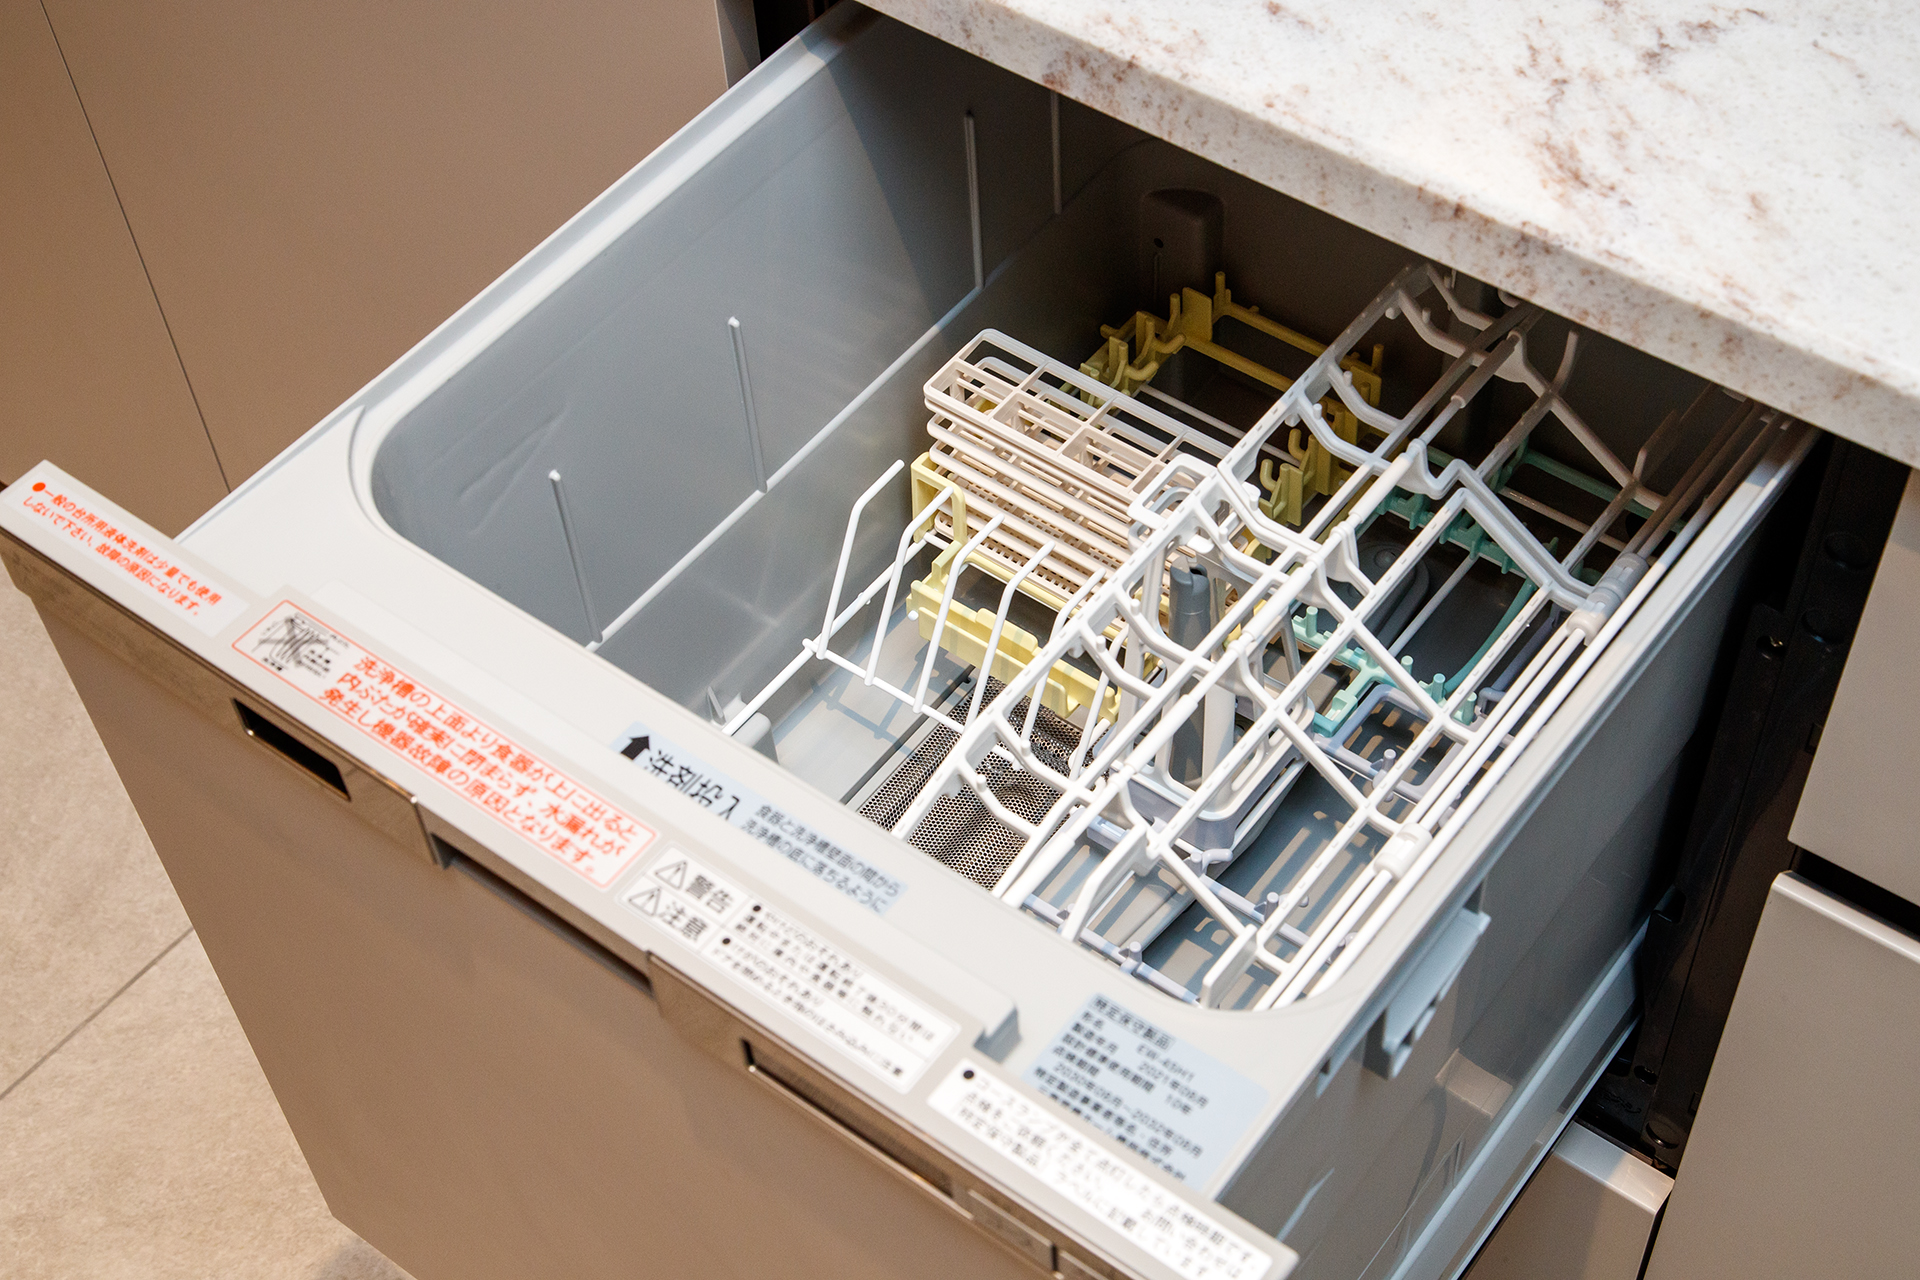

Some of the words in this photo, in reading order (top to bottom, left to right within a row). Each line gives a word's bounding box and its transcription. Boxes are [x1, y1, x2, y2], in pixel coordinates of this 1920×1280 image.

[317, 689, 596, 874] 発生し機器故障の原因となります。
[336, 671, 625, 858] 内ぶたが確実に閉まらず、水漏れが
[352, 656, 638, 842] 洗浄槽の上面より食器が上に出ると
[684, 873, 735, 915] 警告
[754, 803, 901, 898] 食器と洗浄槽壁面の間から
[656, 901, 709, 942] 注意
